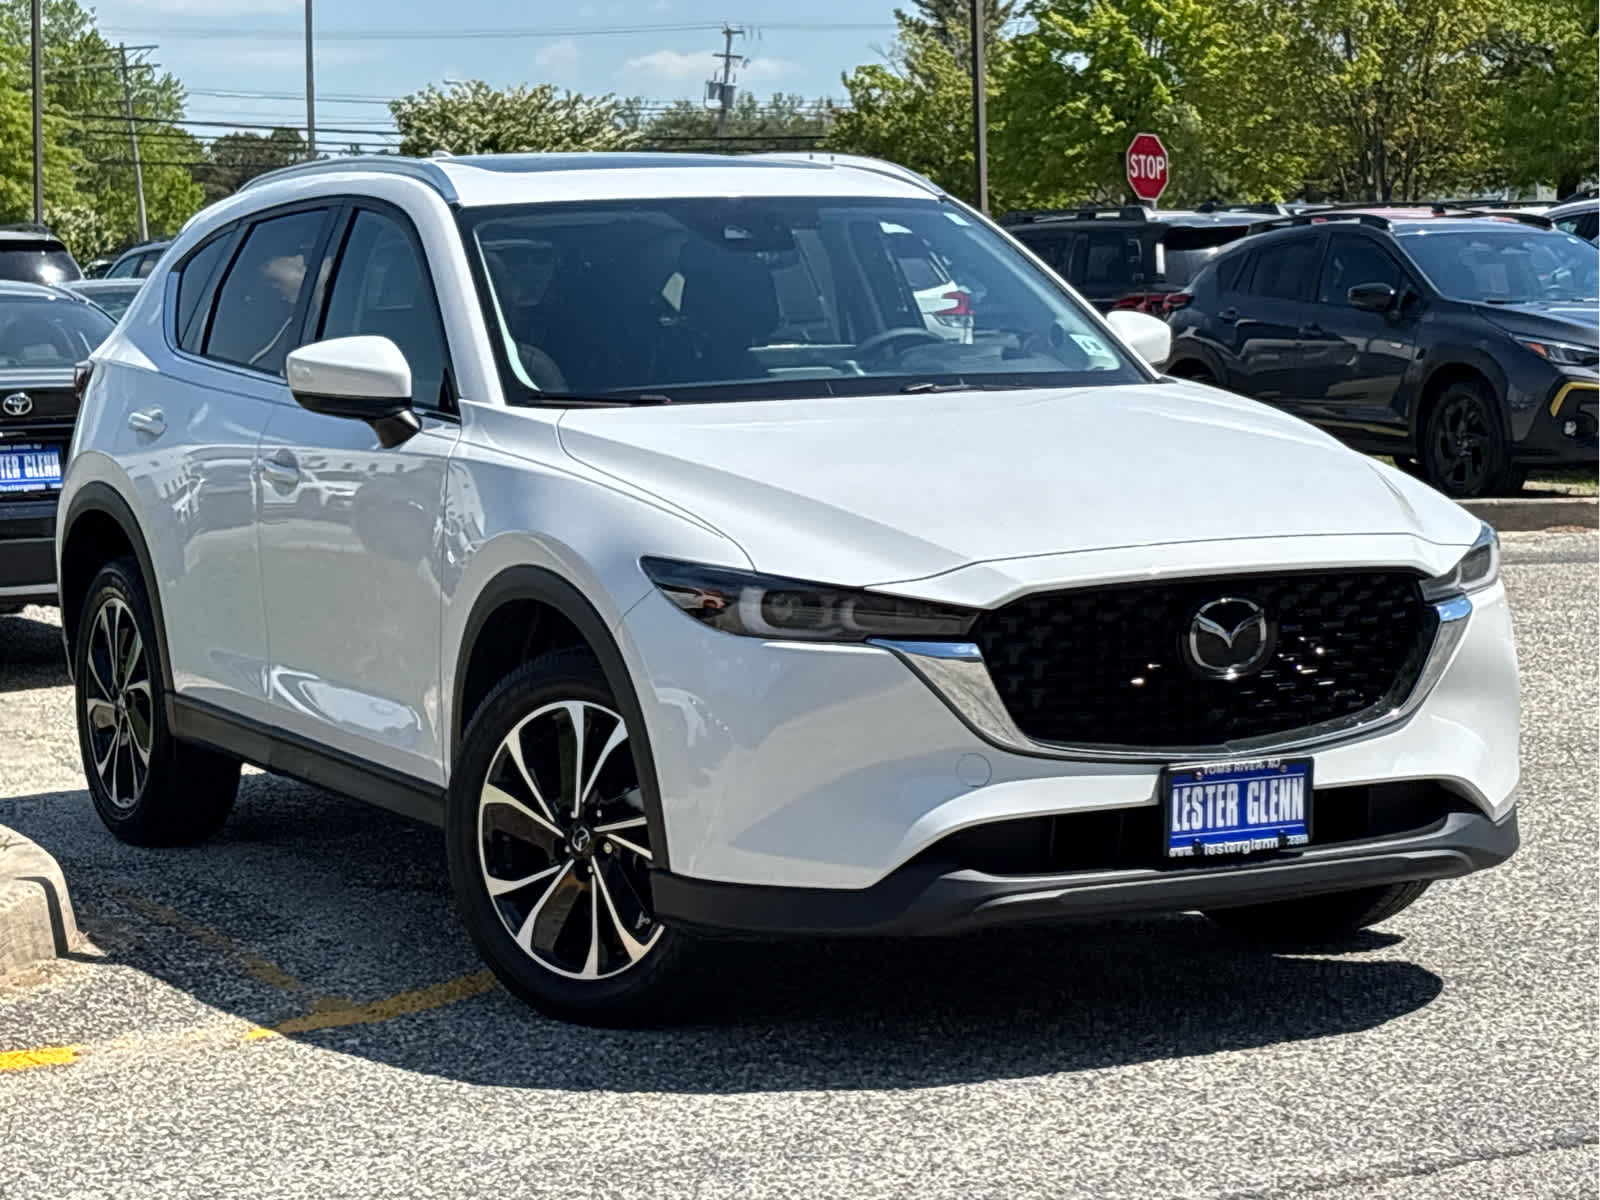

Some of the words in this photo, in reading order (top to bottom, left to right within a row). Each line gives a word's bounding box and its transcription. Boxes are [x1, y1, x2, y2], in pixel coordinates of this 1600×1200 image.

[1130, 154, 1165, 180] STOP
[24, 454, 61, 478] GLENN
[1172, 784, 1239, 832] LESTER
[1247, 776, 1304, 825] GLENN
